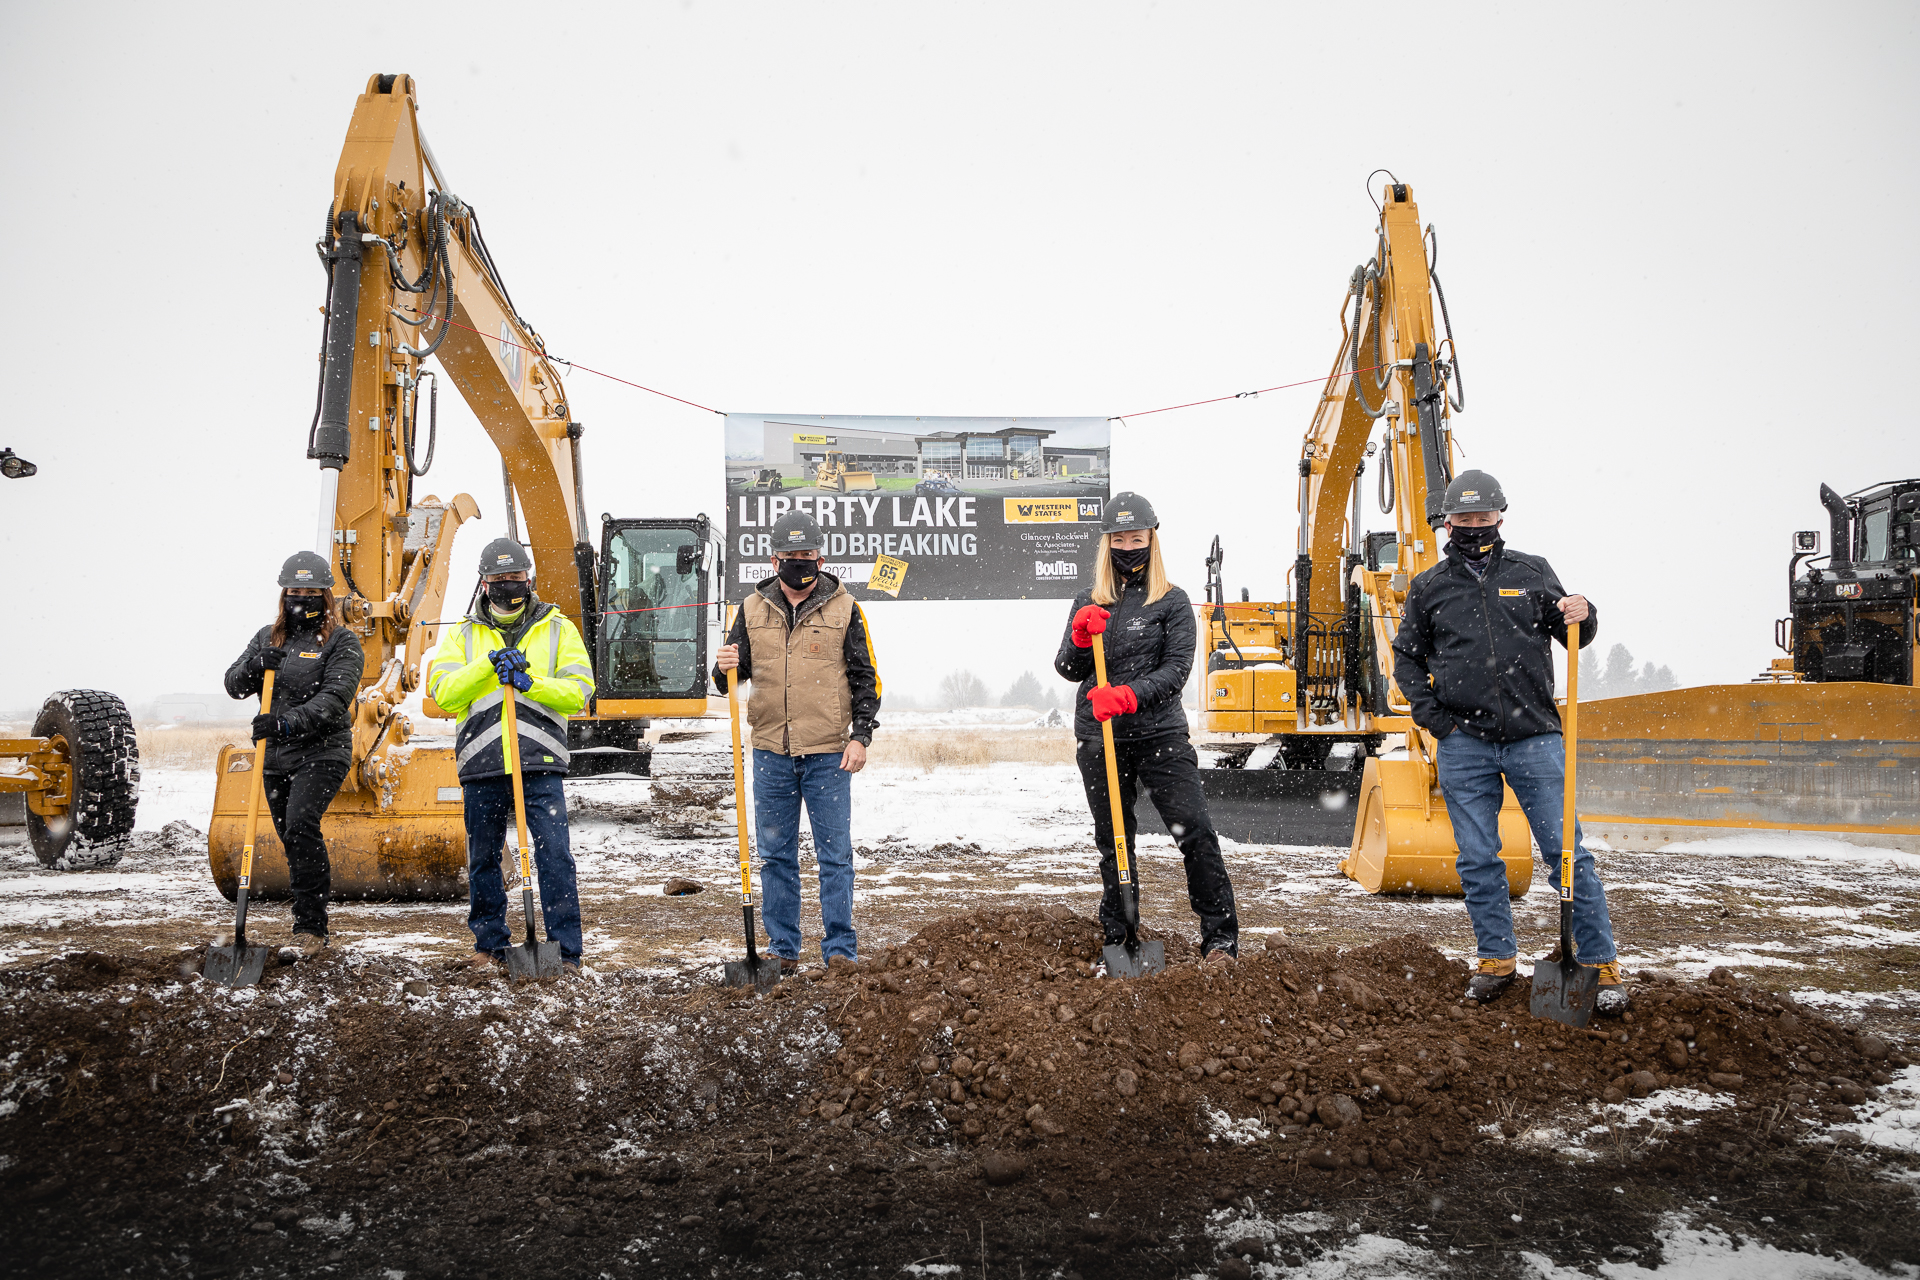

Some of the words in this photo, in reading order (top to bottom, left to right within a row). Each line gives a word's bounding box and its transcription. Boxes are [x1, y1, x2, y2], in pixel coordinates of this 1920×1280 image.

[892, 496, 978, 527] LAKE
[1079, 503, 1100, 516] CAT
[1020, 532, 1051, 542] Glancey
[1055, 532, 1089, 540] Rockwell
[879, 563, 899, 581] 65
[870, 574, 899, 588] years
[1836, 584, 1857, 596] CAT
[1215, 688, 1226, 697] 315
[1120, 870, 1128, 881] CAT
